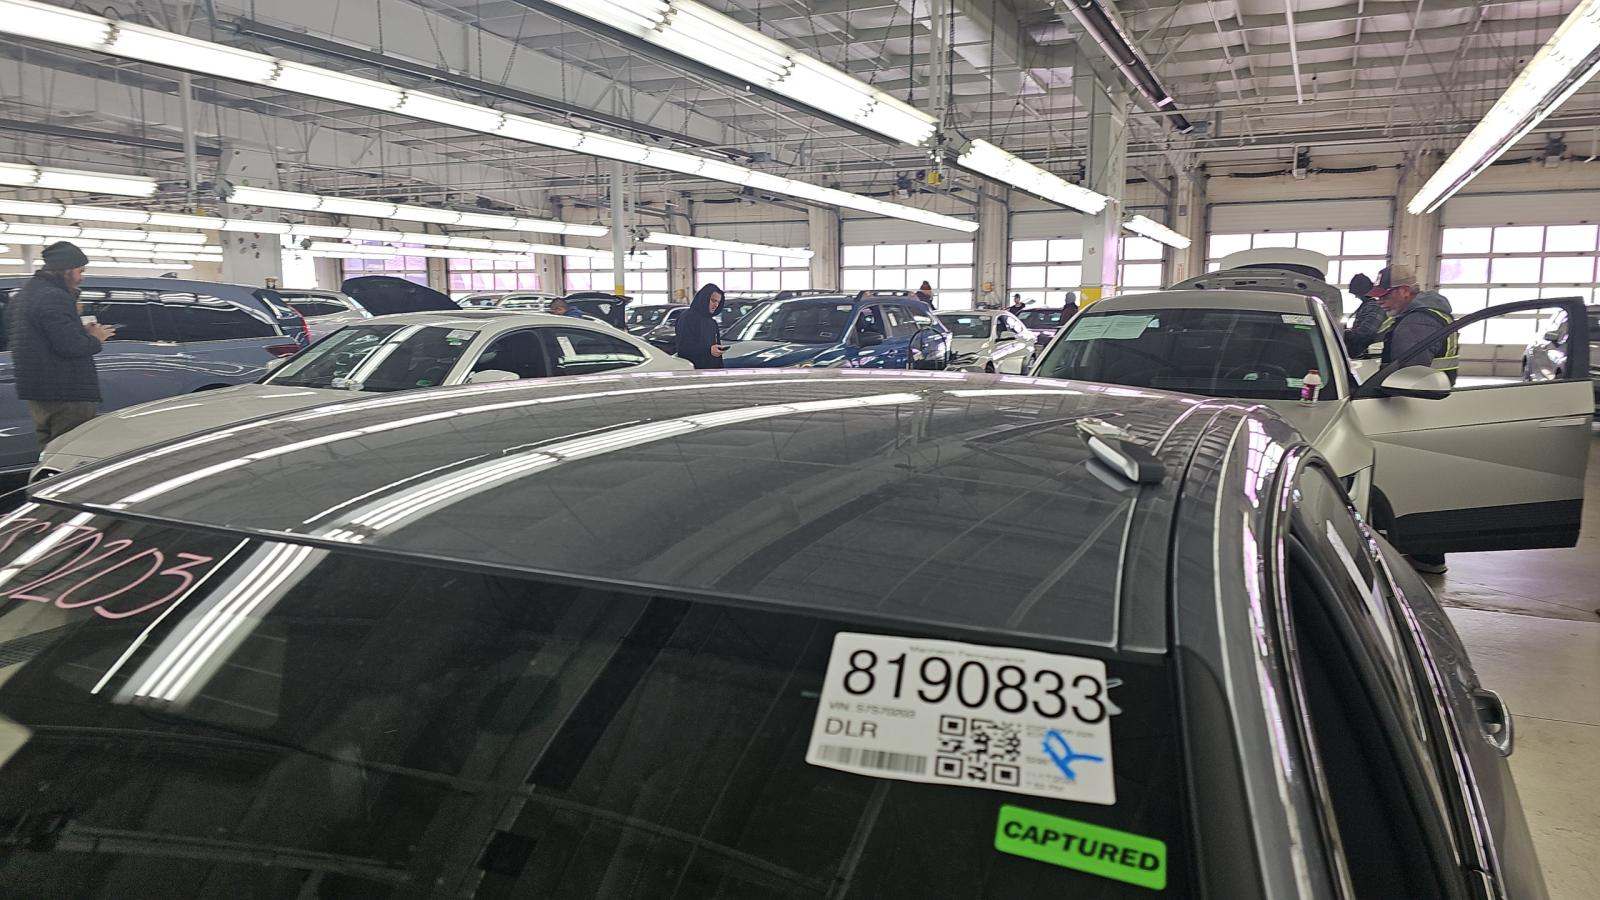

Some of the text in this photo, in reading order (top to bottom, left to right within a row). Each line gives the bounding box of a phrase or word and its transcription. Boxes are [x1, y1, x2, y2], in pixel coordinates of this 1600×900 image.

[843, 649, 1106, 724] 8190833
[824, 718, 878, 739] DLR
[1003, 820, 1161, 872] CAPTURED
